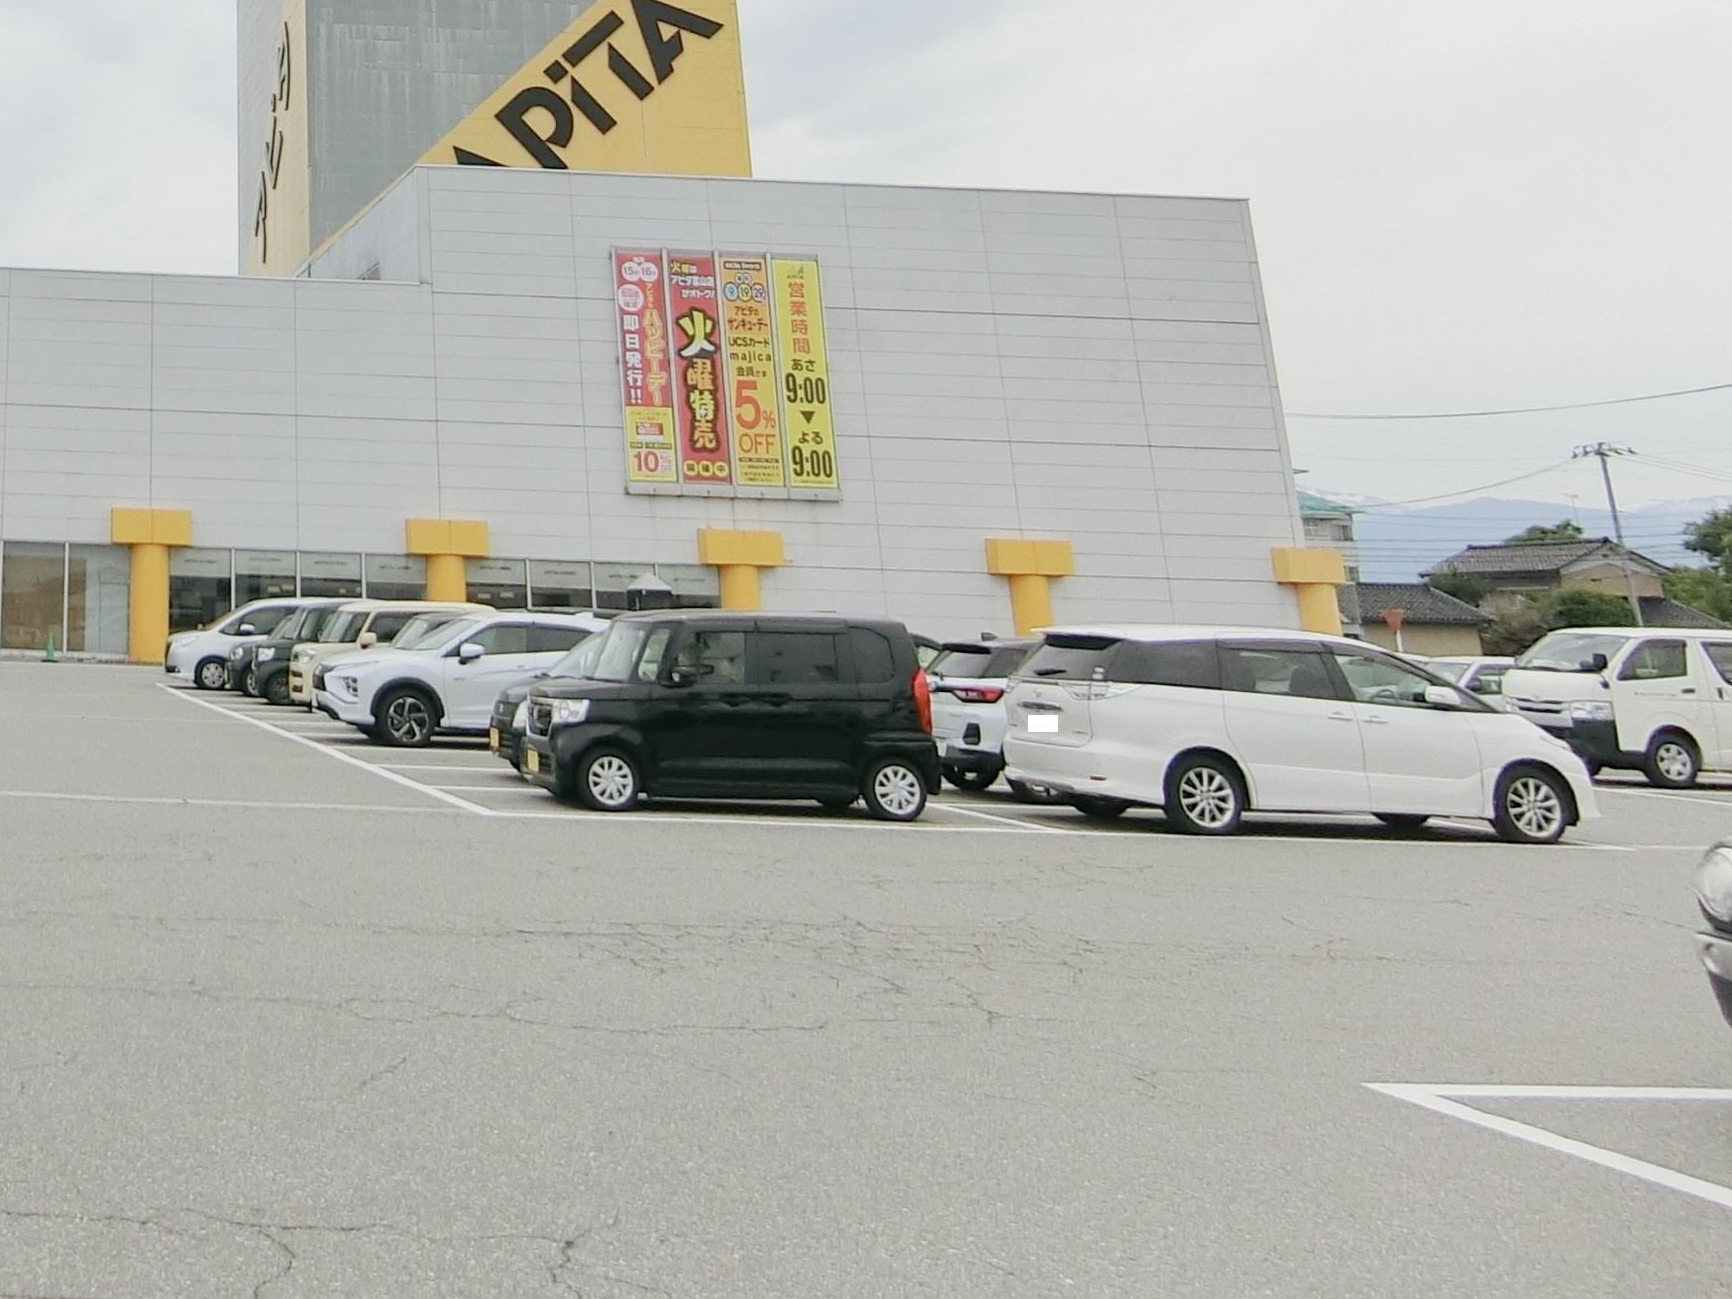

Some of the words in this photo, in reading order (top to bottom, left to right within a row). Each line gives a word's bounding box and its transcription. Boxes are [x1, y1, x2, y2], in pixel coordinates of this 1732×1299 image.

[740, 286, 750, 298] 19
[787, 281, 811, 355] 営業時間
[729, 351, 772, 363] majica
[791, 358, 816, 372] あさ
[785, 372, 826, 405] 9:00
[739, 433, 776, 454] OFF
[798, 431, 824, 445] よる
[791, 445, 833, 478] 9:00
